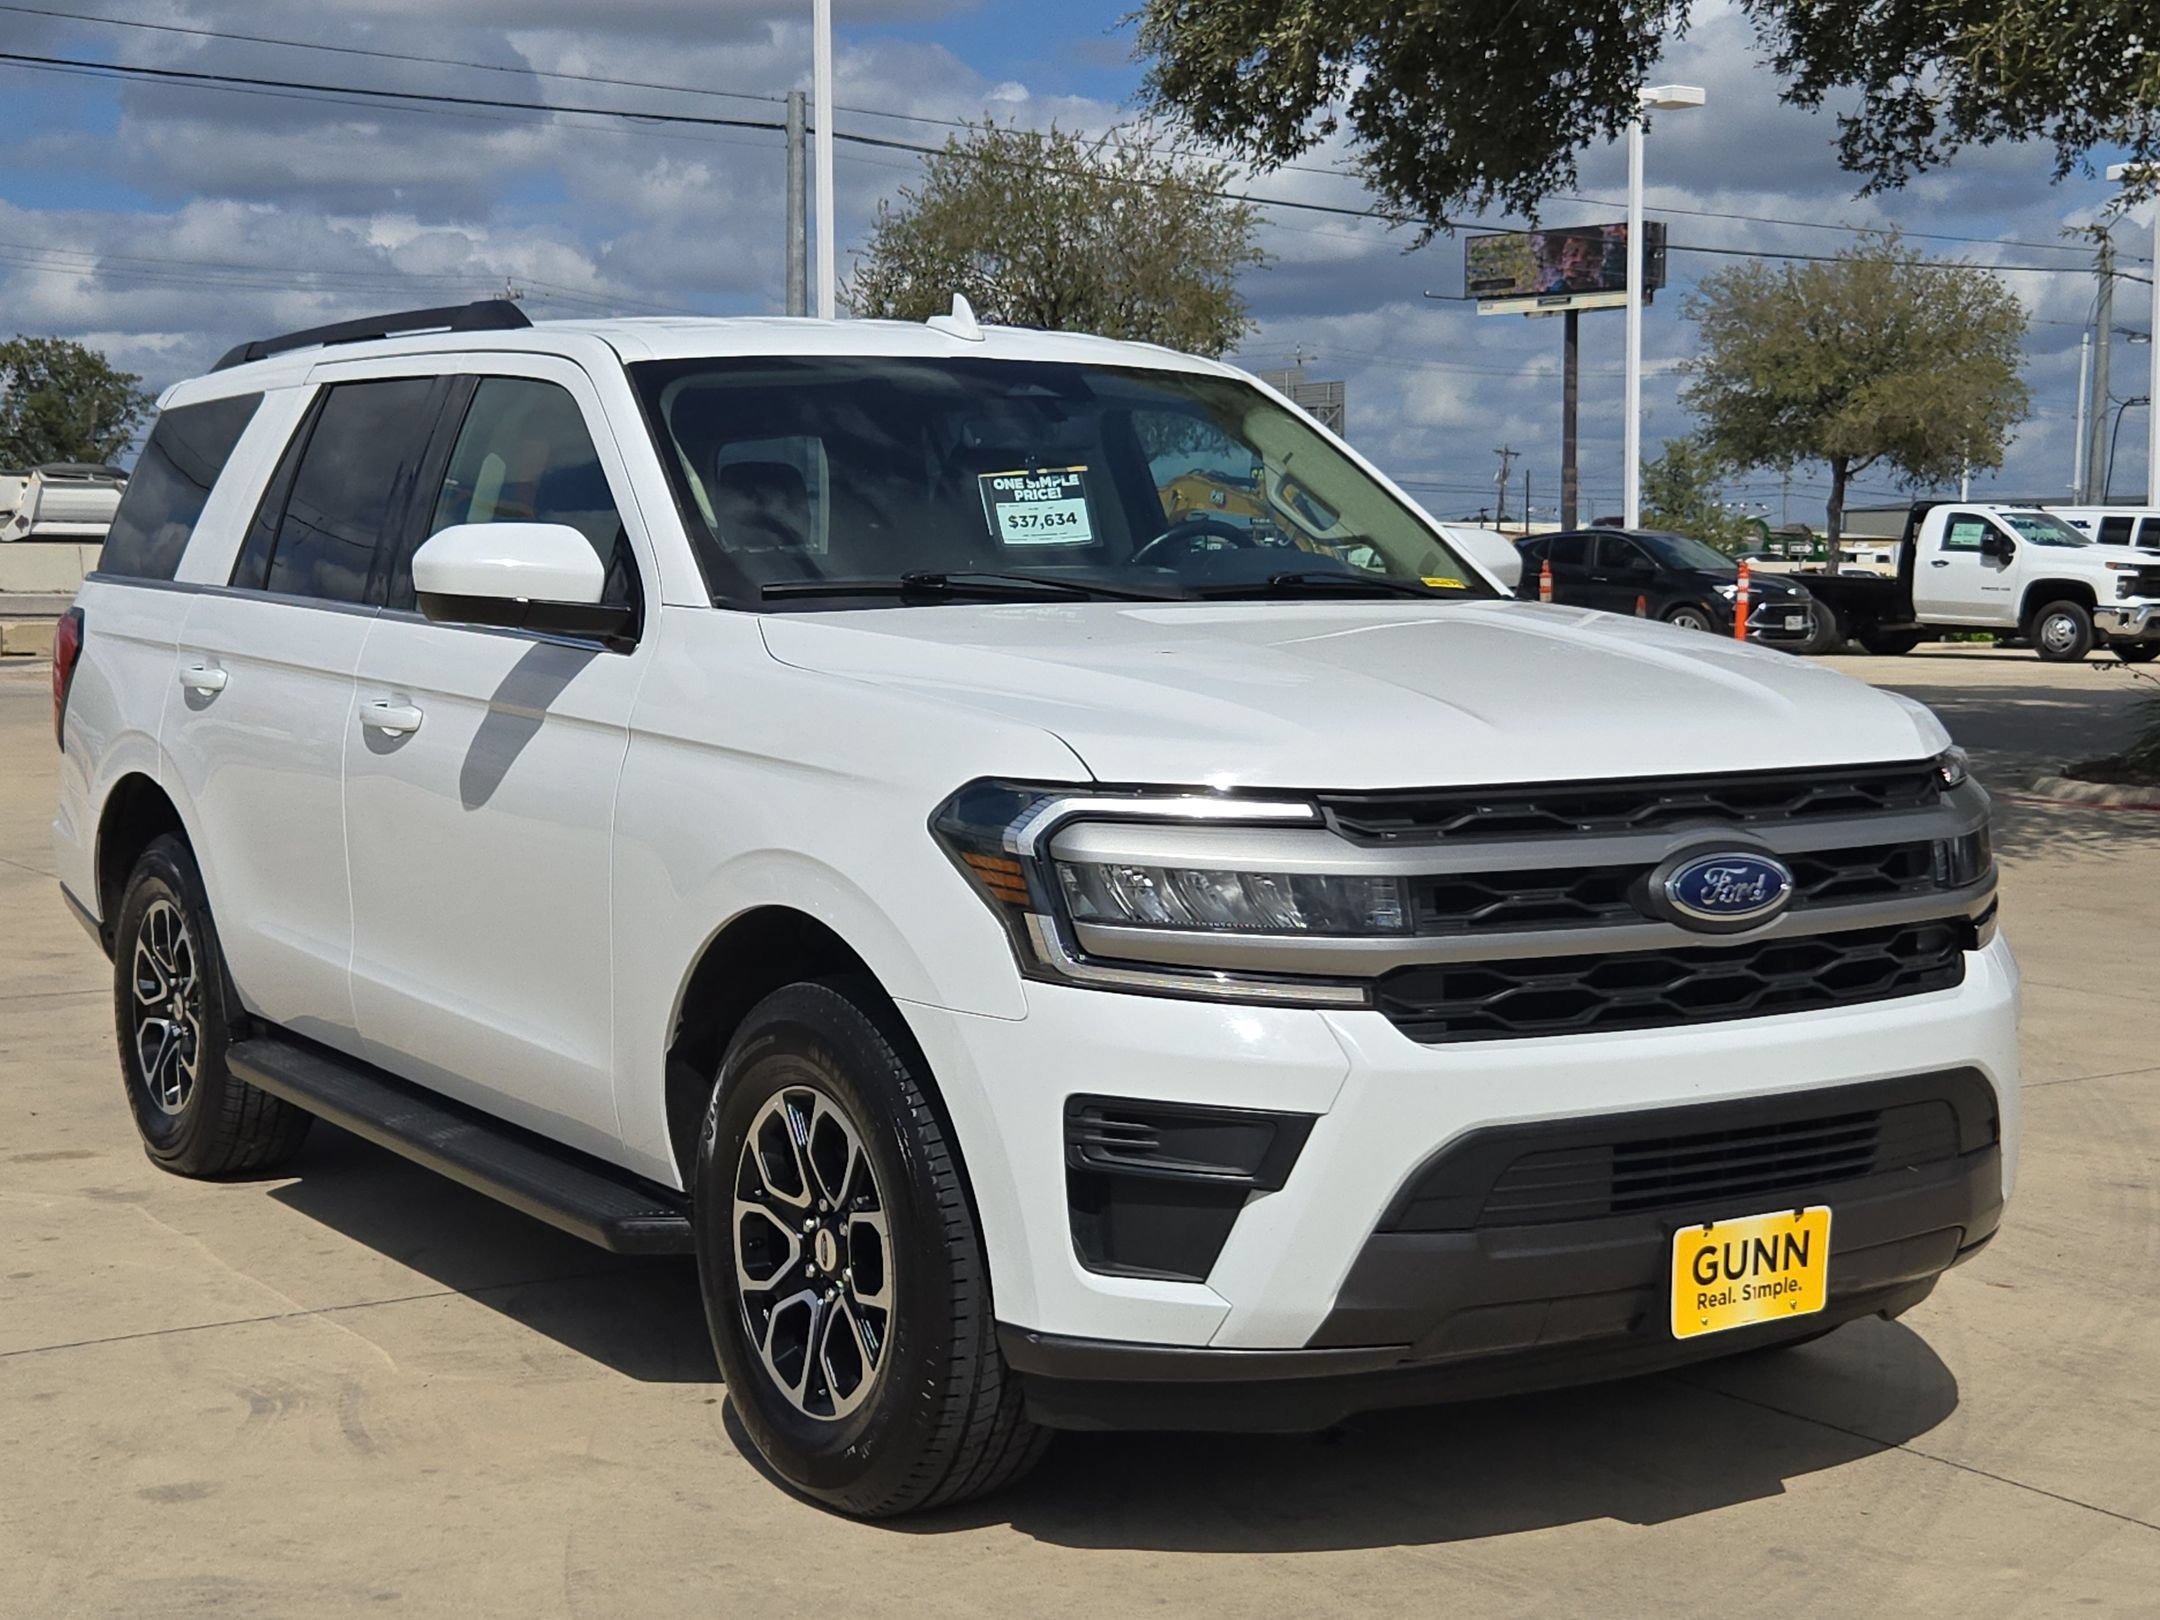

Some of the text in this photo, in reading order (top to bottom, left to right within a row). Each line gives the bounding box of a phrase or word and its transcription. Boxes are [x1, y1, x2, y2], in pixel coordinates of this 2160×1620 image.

[993, 474, 1080, 490] ONE SIMPLE
[1014, 487, 1062, 501] PRICE!
[1008, 512, 1078, 530] $37,634
[1701, 867, 1766, 905] Ford
[1692, 1230, 1810, 1286] GUNN
[1697, 1277, 1803, 1310] Real. Simple.
